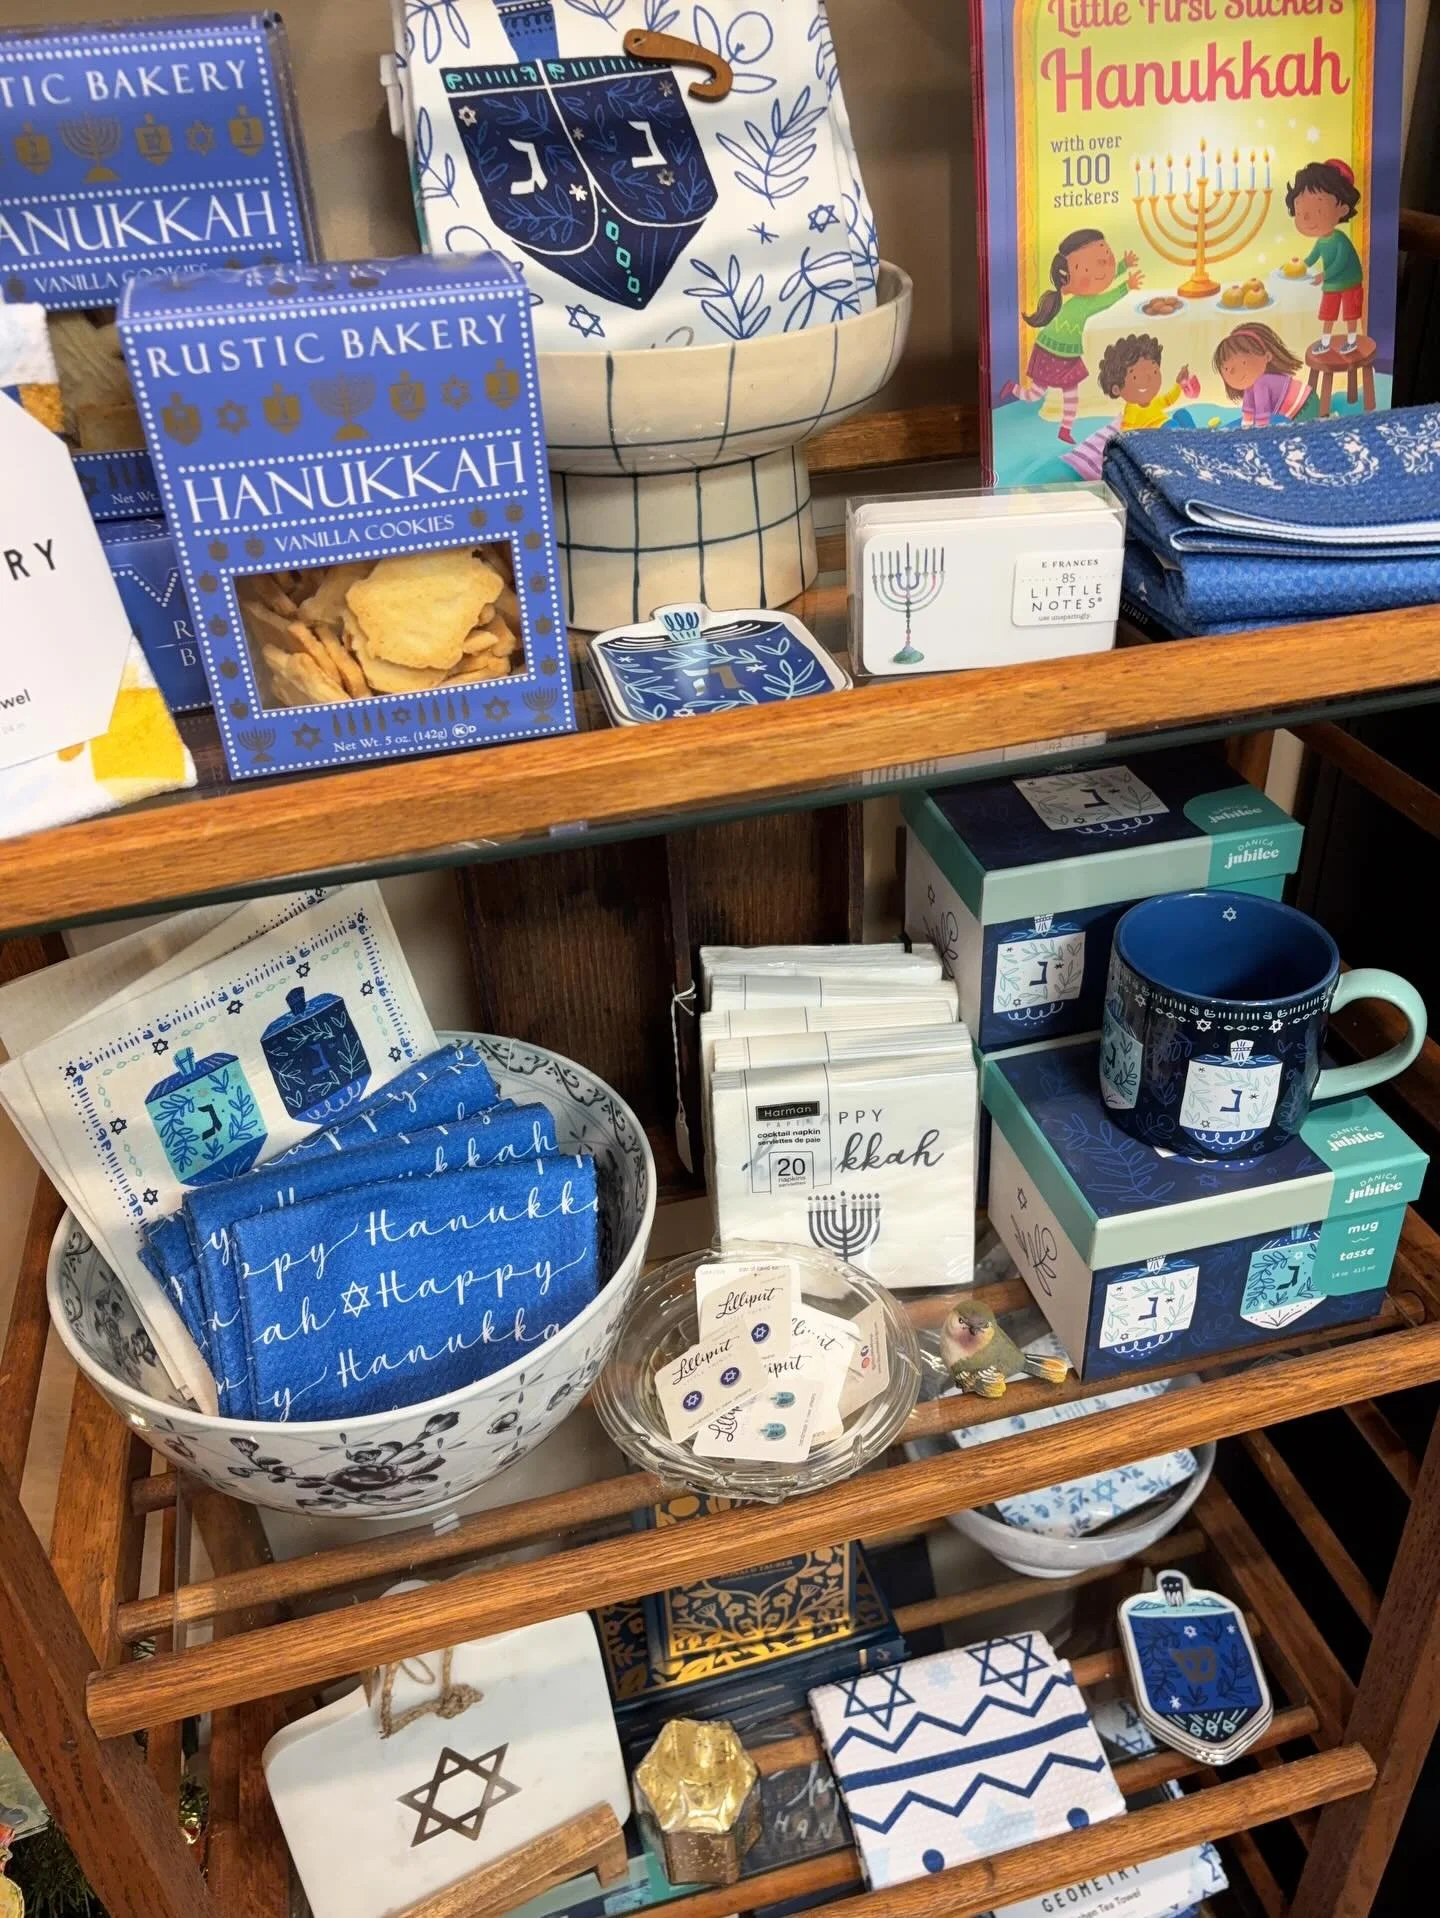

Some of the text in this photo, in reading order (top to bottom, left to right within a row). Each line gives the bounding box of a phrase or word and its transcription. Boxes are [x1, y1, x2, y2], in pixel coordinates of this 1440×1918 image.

[1048, 0, 1131, 38] Little
[1138, 0, 1216, 24] First
[0, 60, 245, 108] TIC BAKERY
[1040, 36, 1350, 112] Hanukkah
[1051, 134, 1122, 153] with over
[1062, 153, 1110, 187] 100
[1054, 188, 1119, 208] stickers
[34, 271, 119, 294] VANILLA
[147, 314, 507, 378] RUSTIC BAKERY
[184, 440, 526, 523] HANUKKAH
[273, 514, 456, 553] VANILLA COOKIES
[1052, 559, 1099, 568] FRANCES
[1061, 572, 1076, 583] 85
[1031, 583, 1102, 599] LITTLE
[332, 741, 357, 753] Net
[360, 737, 383, 749] Wt.
[385, 735, 392, 745] 5
[395, 736, 411, 744] oz.
[413, 727, 448, 744] (142g)
[1238, 838, 1274, 851] DANICA
[1224, 847, 1280, 869] jubilee
[764, 1105, 812, 1117] Harman
[838, 1108, 883, 1125] PPY
[757, 1128, 821, 1139] cocktail napkin
[1326, 1130, 1385, 1152] jubilee
[1330, 1125, 1370, 1139] DANICA
[778, 1157, 806, 1177] 20
[1360, 1172, 1398, 1187] DANICA
[1344, 1180, 1404, 1204] jubilee
[366, 1180, 600, 1246] Hanukk
[1348, 1220, 1379, 1235] mug
[1339, 1246, 1375, 1261] tasse
[377, 1246, 586, 1306] Happy
[716, 1287, 783, 1319] Lilliput
[672, 1336, 740, 1386] Lilliput
[768, 1354, 813, 1378] iput
